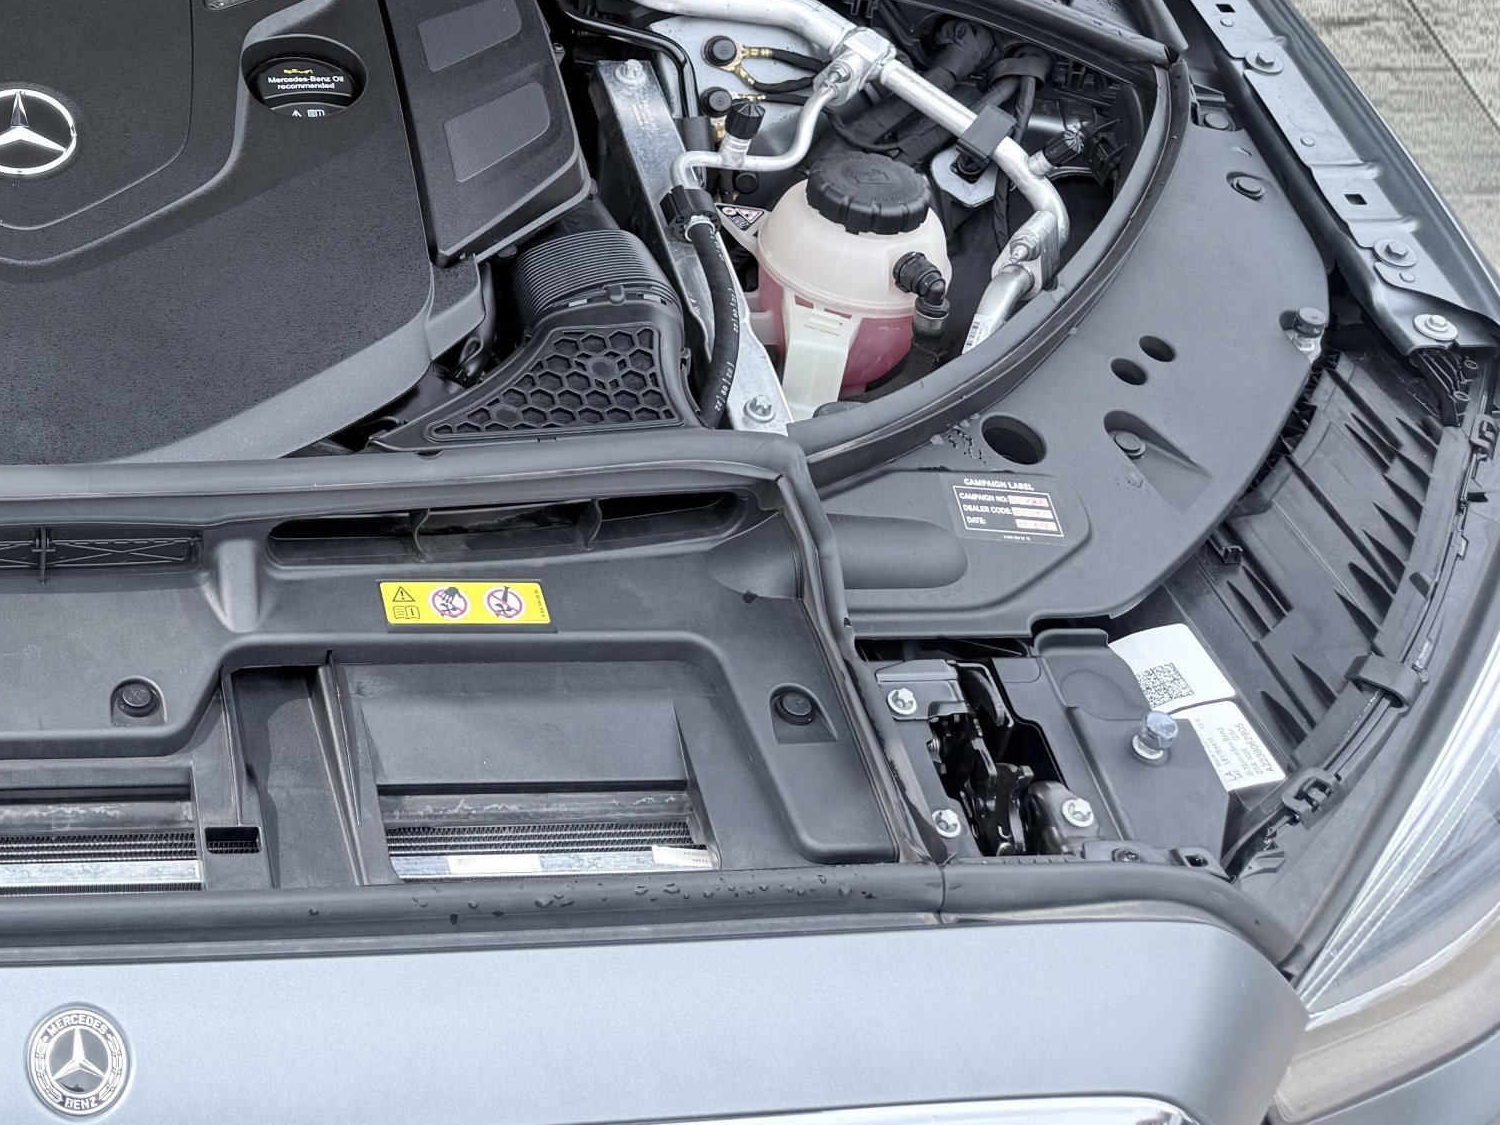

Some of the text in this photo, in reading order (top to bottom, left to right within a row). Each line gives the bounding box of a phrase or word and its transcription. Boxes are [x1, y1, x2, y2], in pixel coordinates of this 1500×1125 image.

[267, 75, 331, 83] Mercedes-Benz
[277, 82, 335, 90] recommended
[963, 478, 1034, 491] CAMPAIGN LABEL
[959, 492, 995, 502] CAMPAIGN
[963, 504, 990, 513] DEALER
[990, 506, 1013, 515] CODE:
[966, 516, 986, 524] DATE:
[46, 1014, 108, 1036] MERCEDES
[64, 1096, 98, 1111] BENZ
